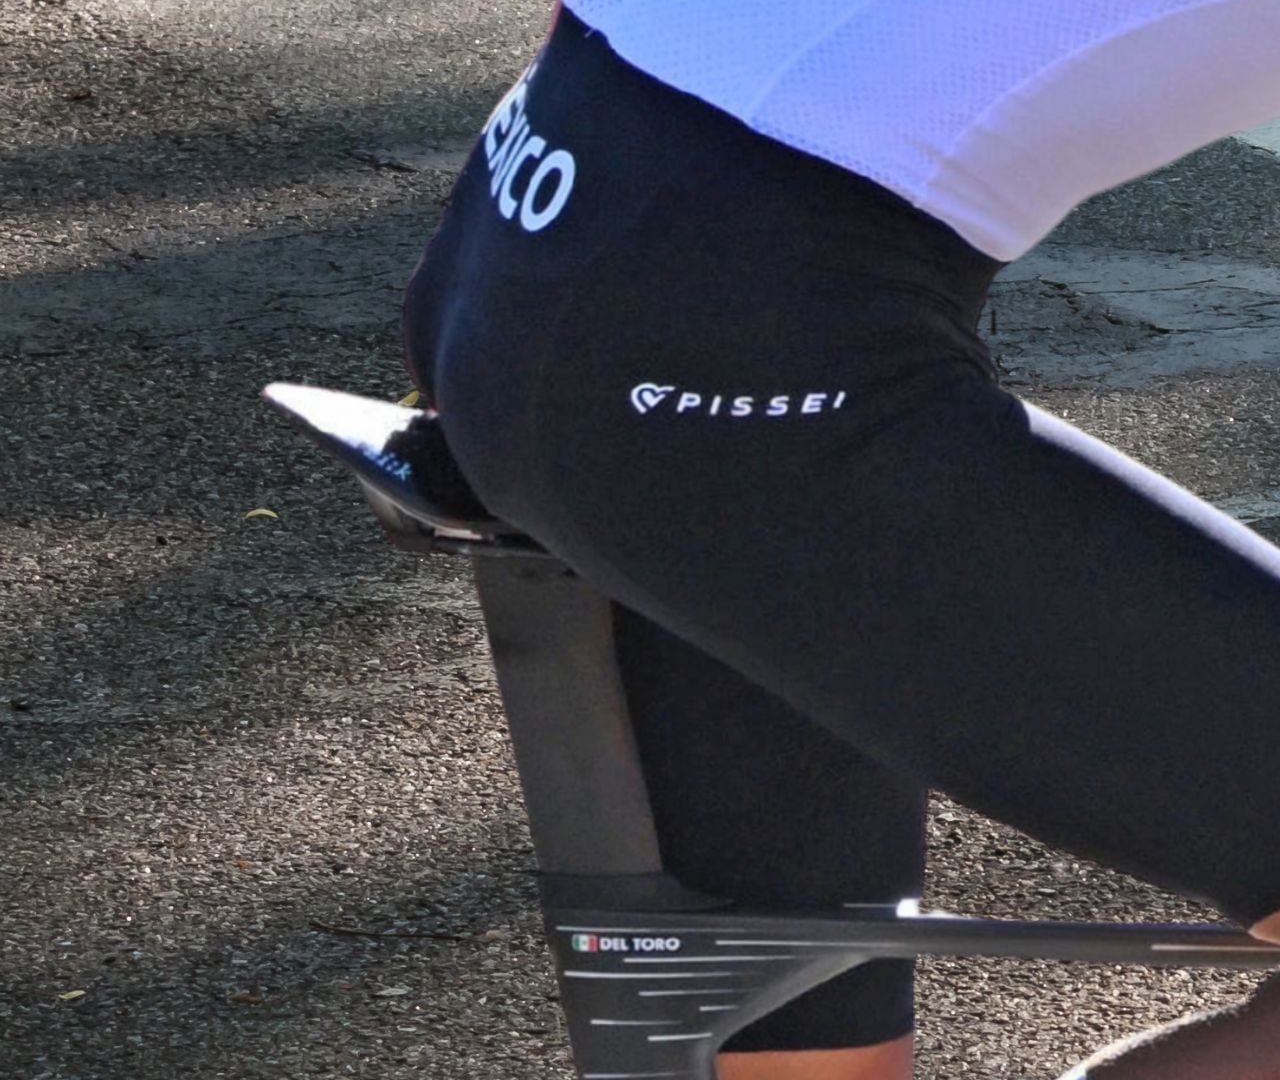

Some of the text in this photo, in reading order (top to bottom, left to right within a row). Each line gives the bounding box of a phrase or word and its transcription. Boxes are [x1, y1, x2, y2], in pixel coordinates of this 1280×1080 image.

[676, 391, 846, 416] PISSEI
[600, 936, 681, 952] DEL TORO
